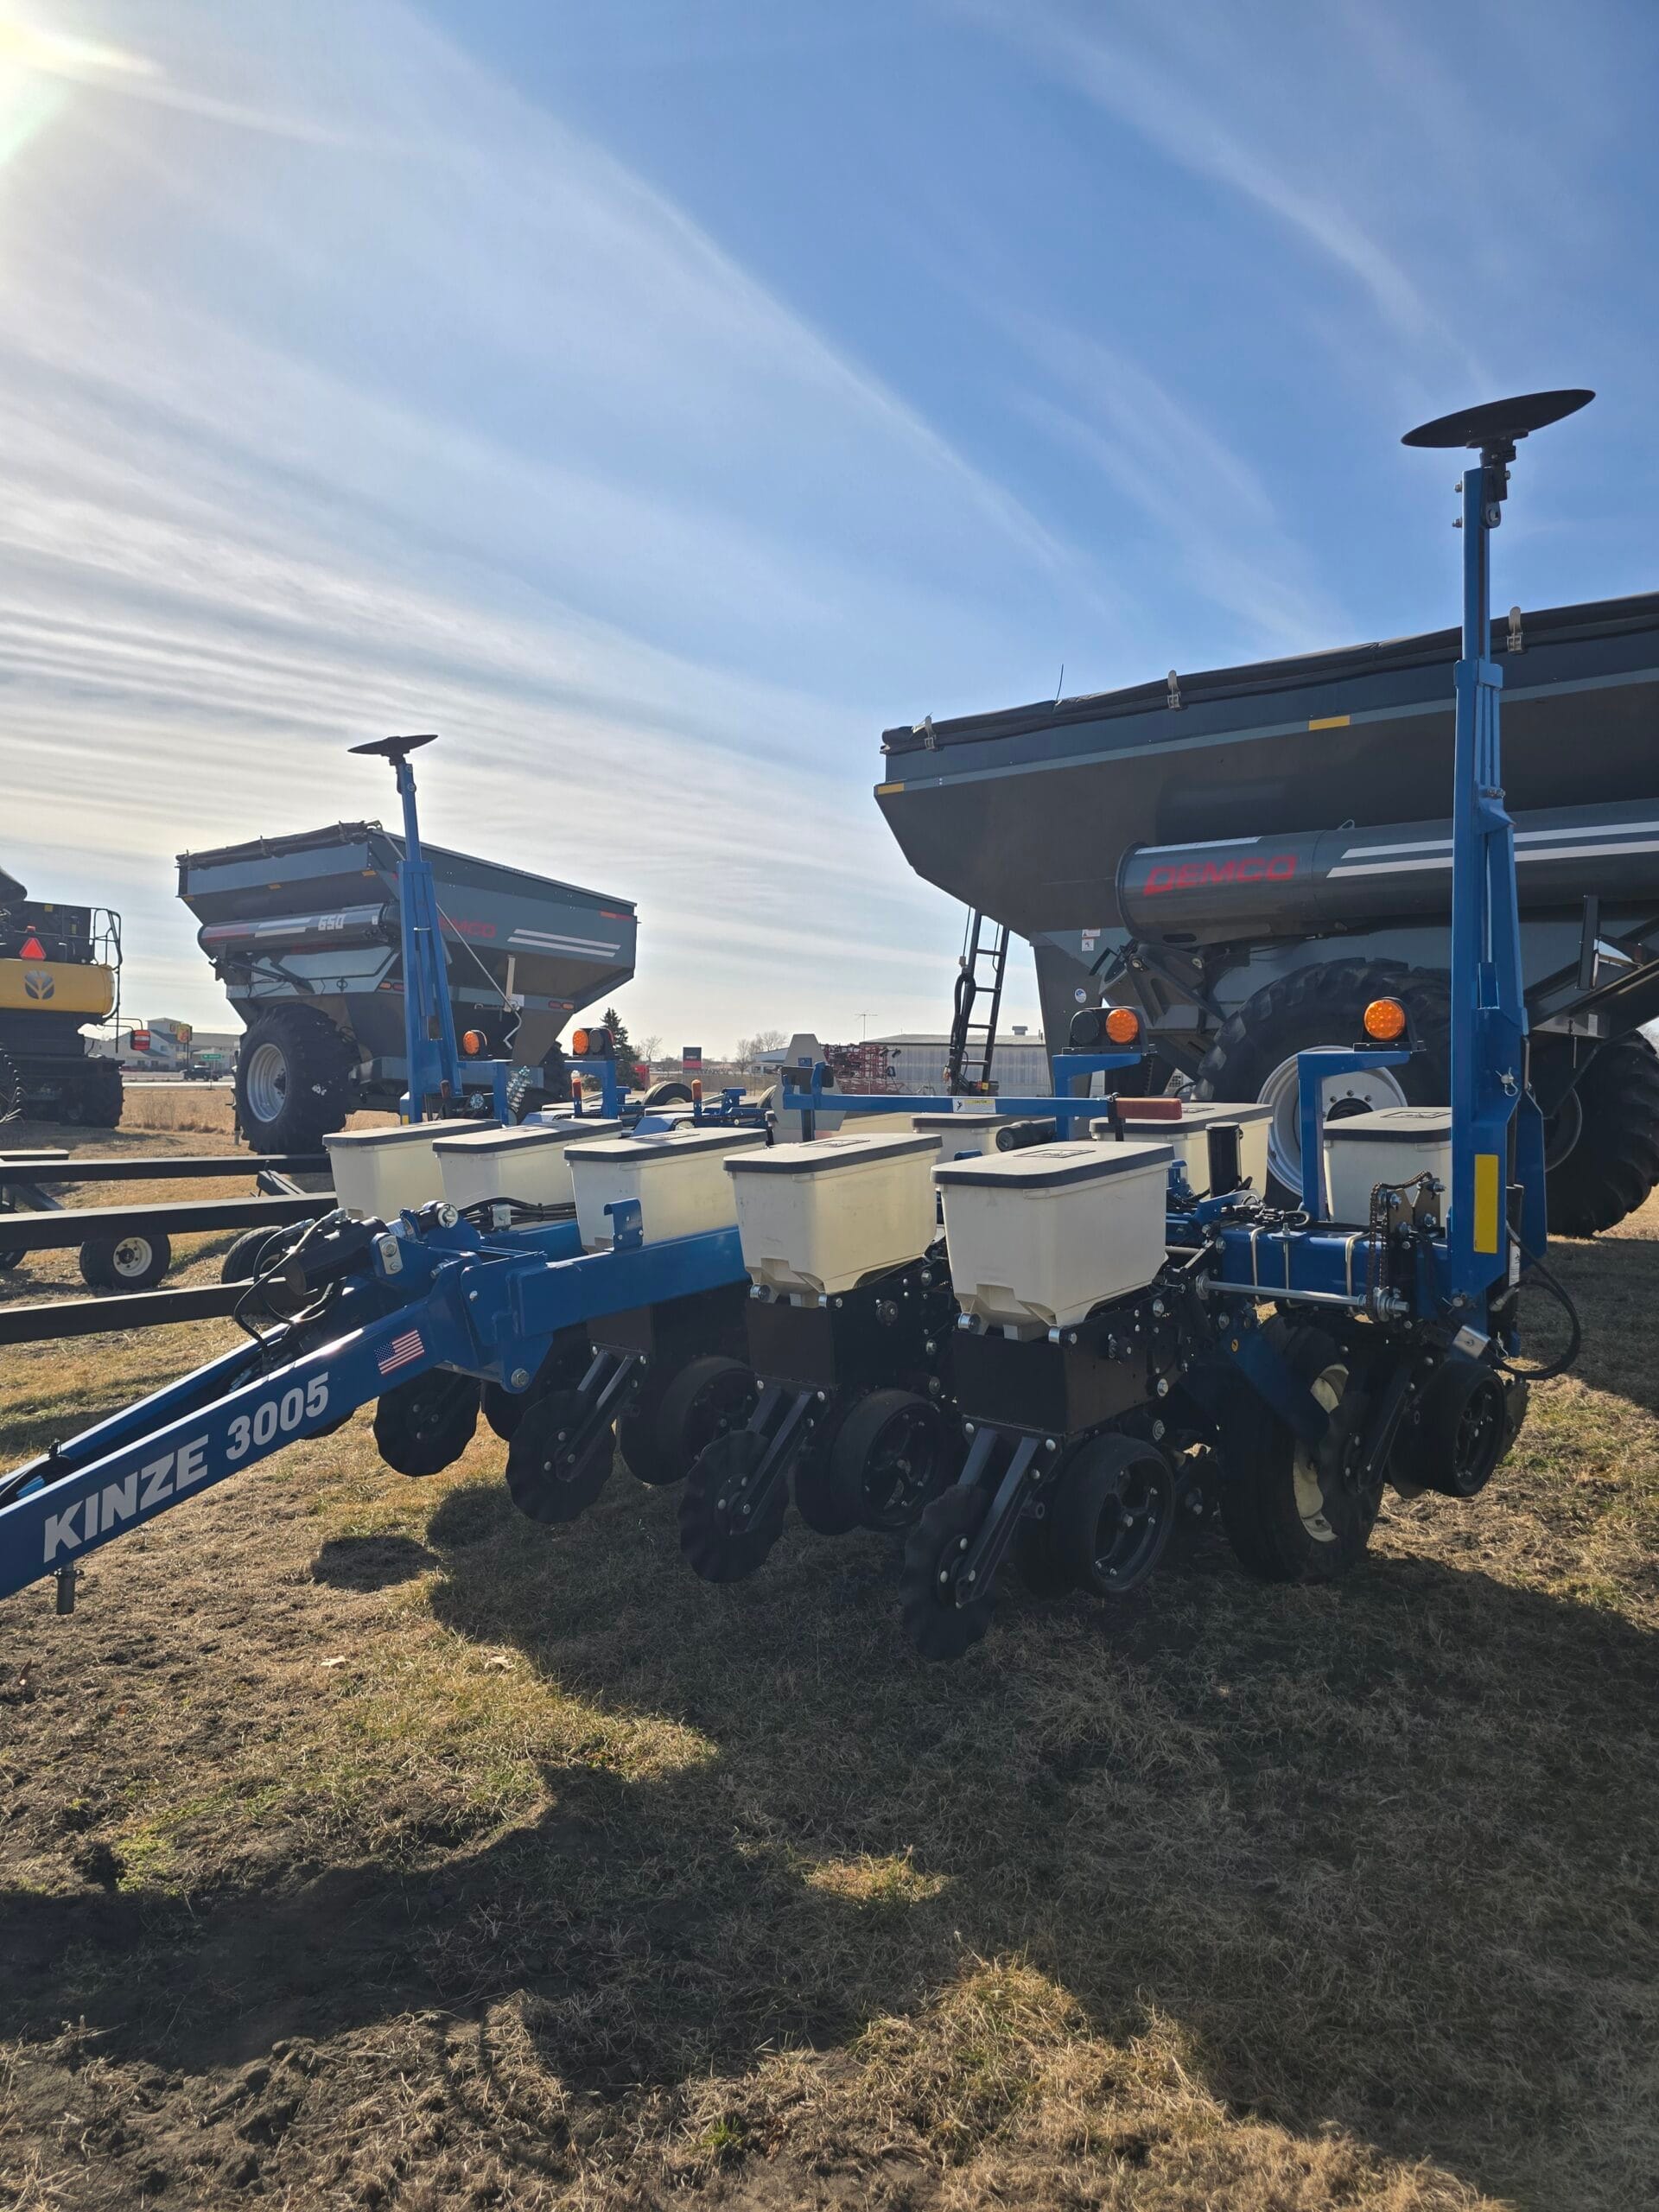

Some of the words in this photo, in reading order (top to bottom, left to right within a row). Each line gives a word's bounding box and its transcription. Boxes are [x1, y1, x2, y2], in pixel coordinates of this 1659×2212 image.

[1143, 855, 1298, 895] DEMCO
[318, 913, 345, 931] 650
[438, 915, 497, 938] EMCO
[43, 1434, 209, 1564] KINZE
[226, 1371, 329, 1460] 3005
